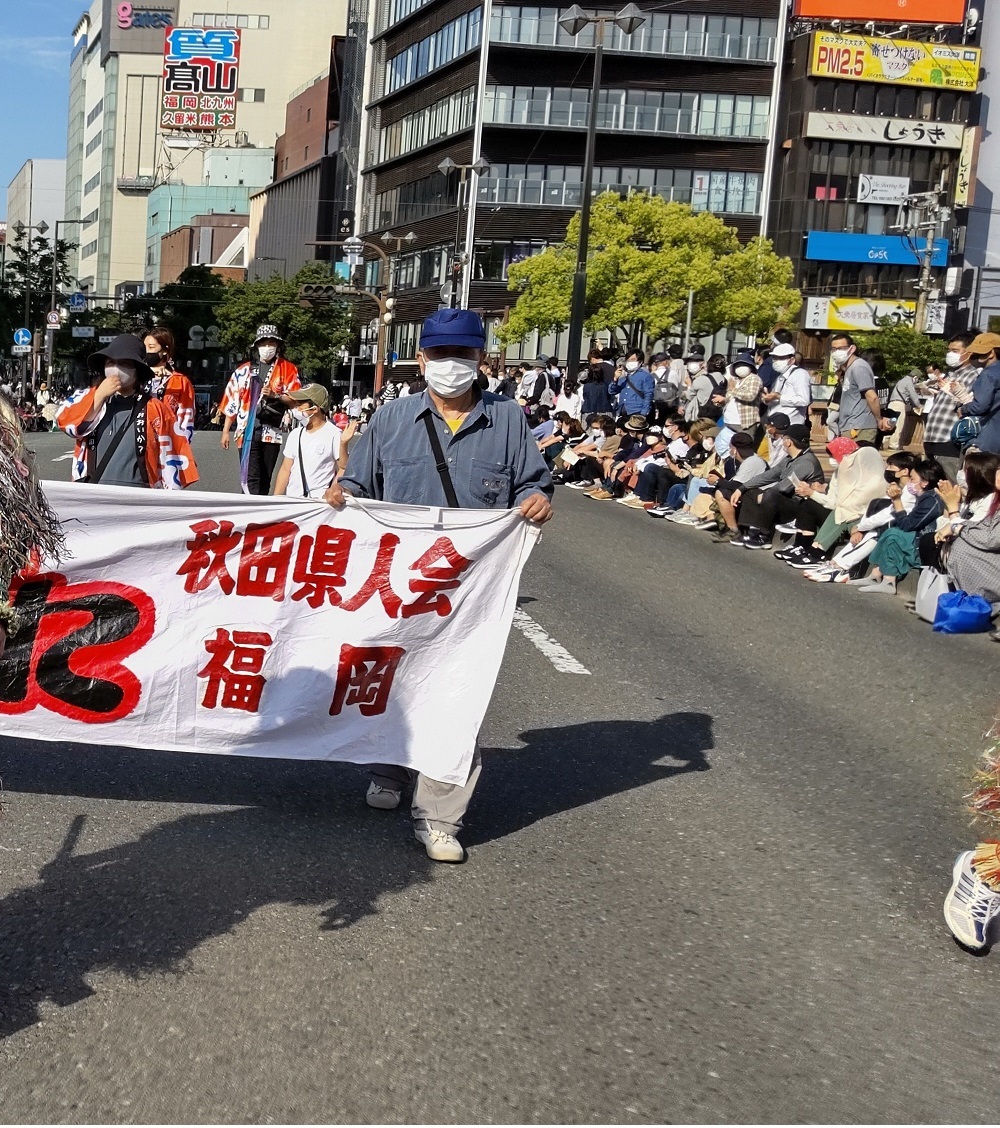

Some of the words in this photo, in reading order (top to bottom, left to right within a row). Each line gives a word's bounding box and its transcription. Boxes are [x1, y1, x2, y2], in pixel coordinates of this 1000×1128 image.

[167, 29, 239, 61] 質
[816, 46, 865, 76] PM2.5
[163, 96, 197, 109] 福岡
[200, 96, 235, 110] 北九州
[162, 112, 197, 125] 久留米
[200, 113, 234, 126] 熊本
[177, 519, 472, 619] 秋田県人会
[197, 628, 406, 716] 福岡
